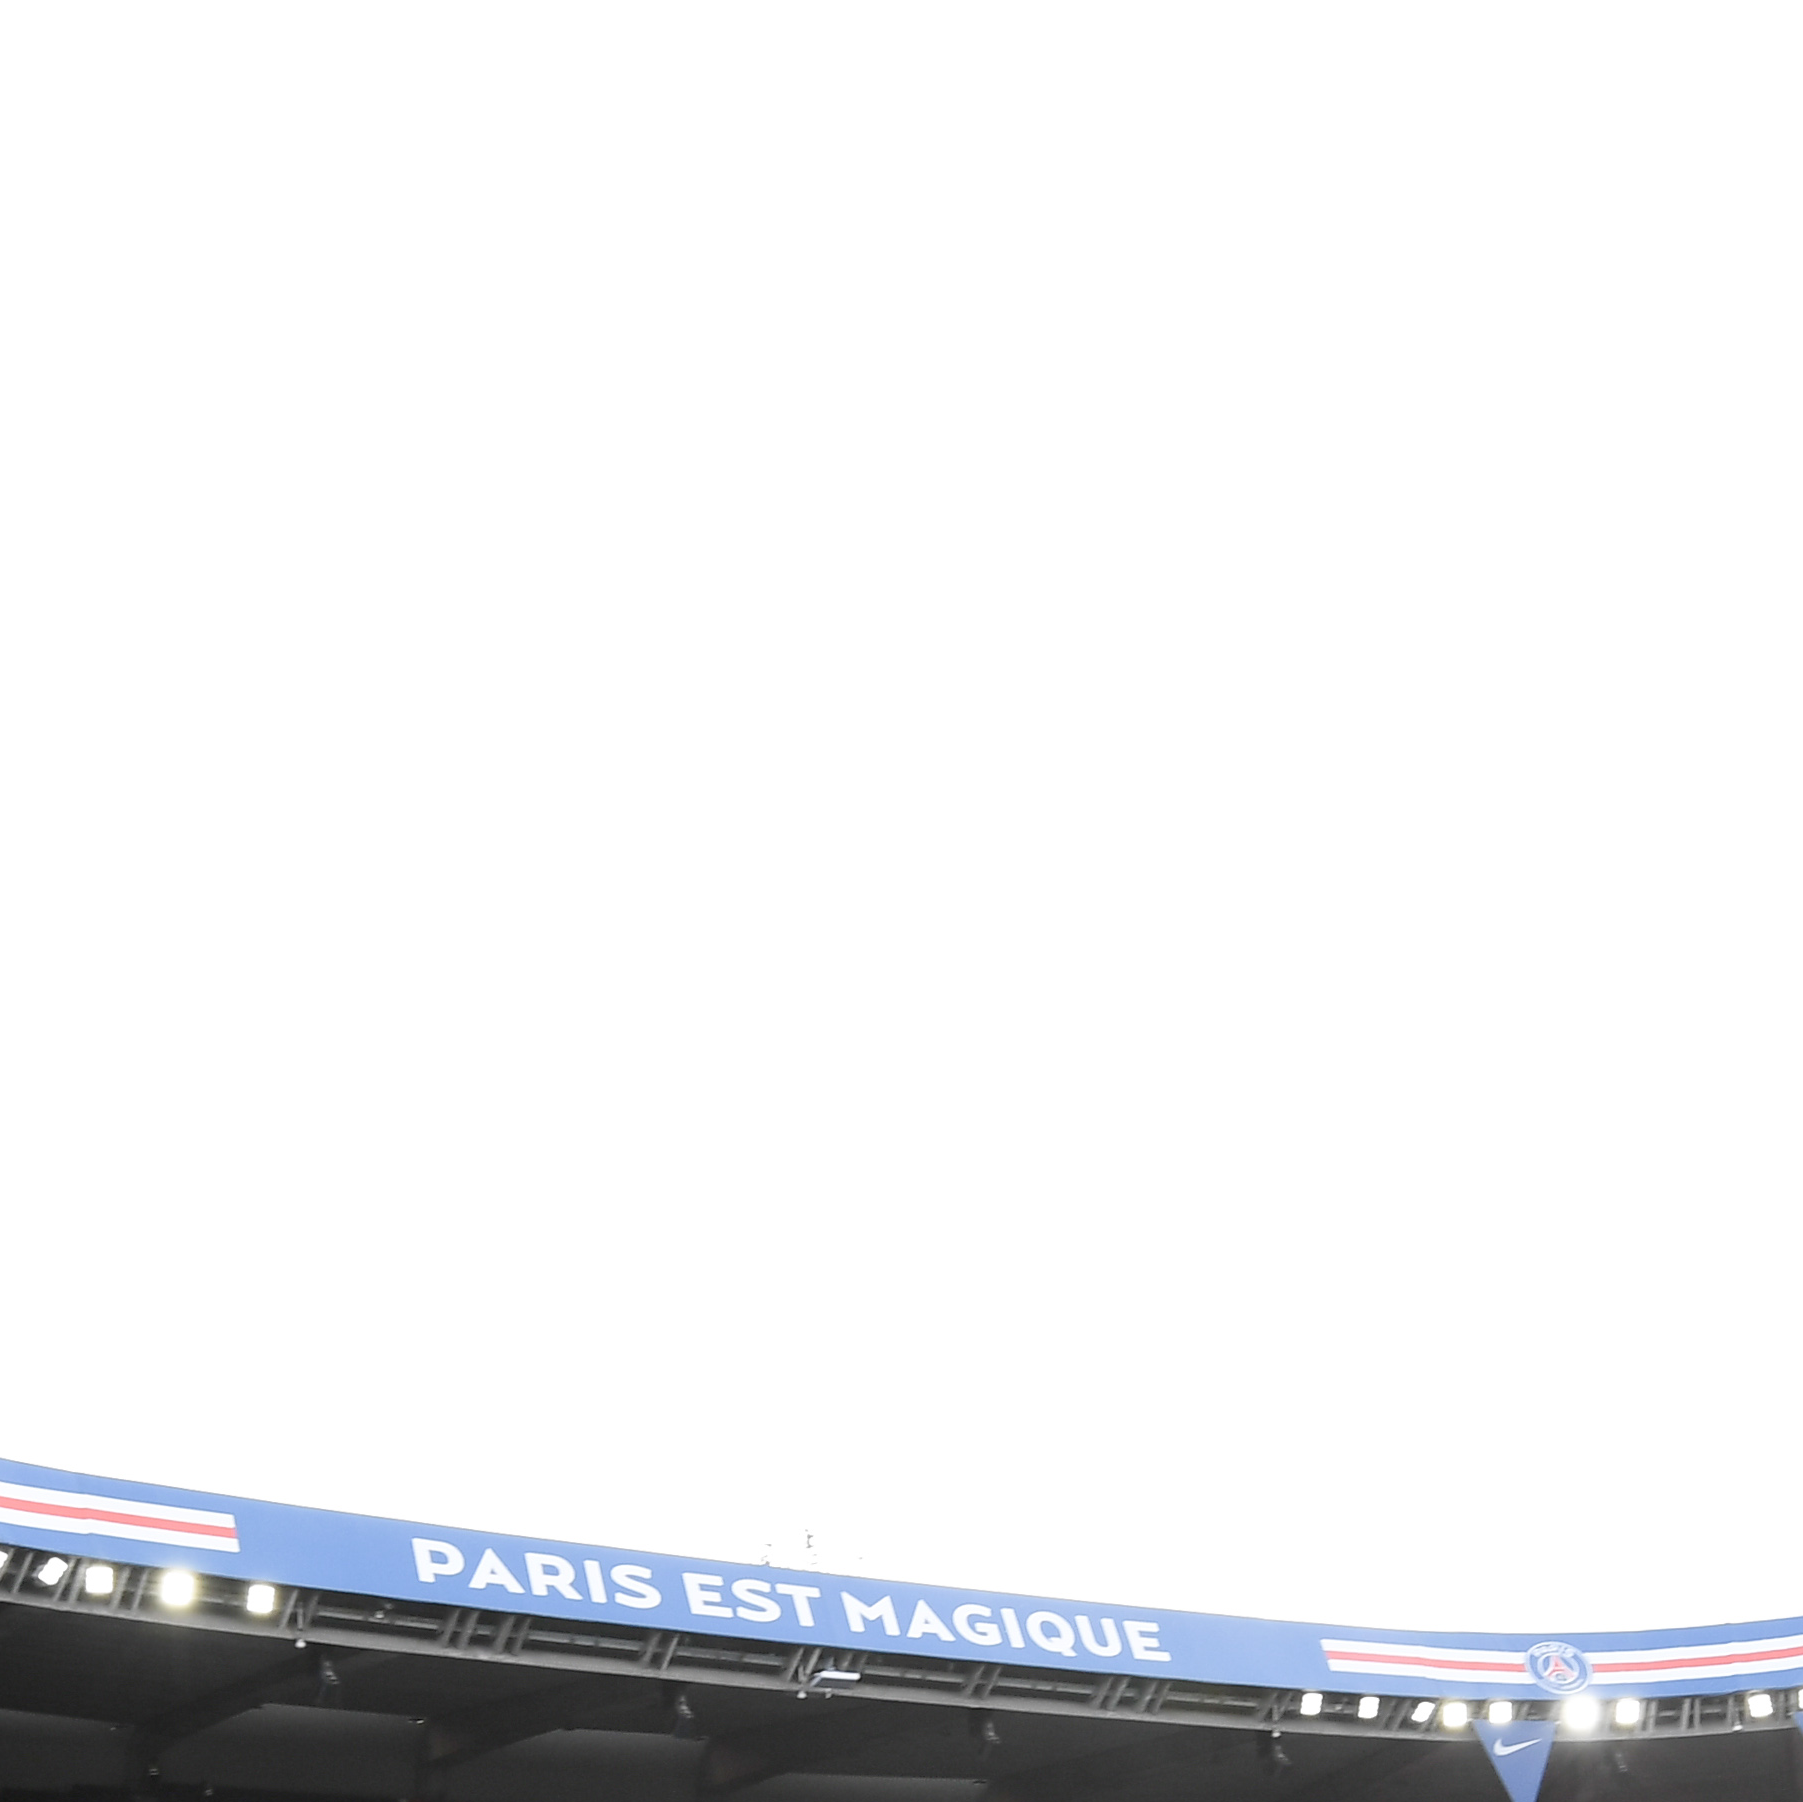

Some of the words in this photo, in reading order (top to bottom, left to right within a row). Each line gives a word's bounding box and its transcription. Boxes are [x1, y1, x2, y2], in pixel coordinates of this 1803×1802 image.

[411, 1537, 663, 1610] PARIS
[680, 1571, 820, 1627] EST
[839, 1590, 1172, 1662] MAGIQUE
